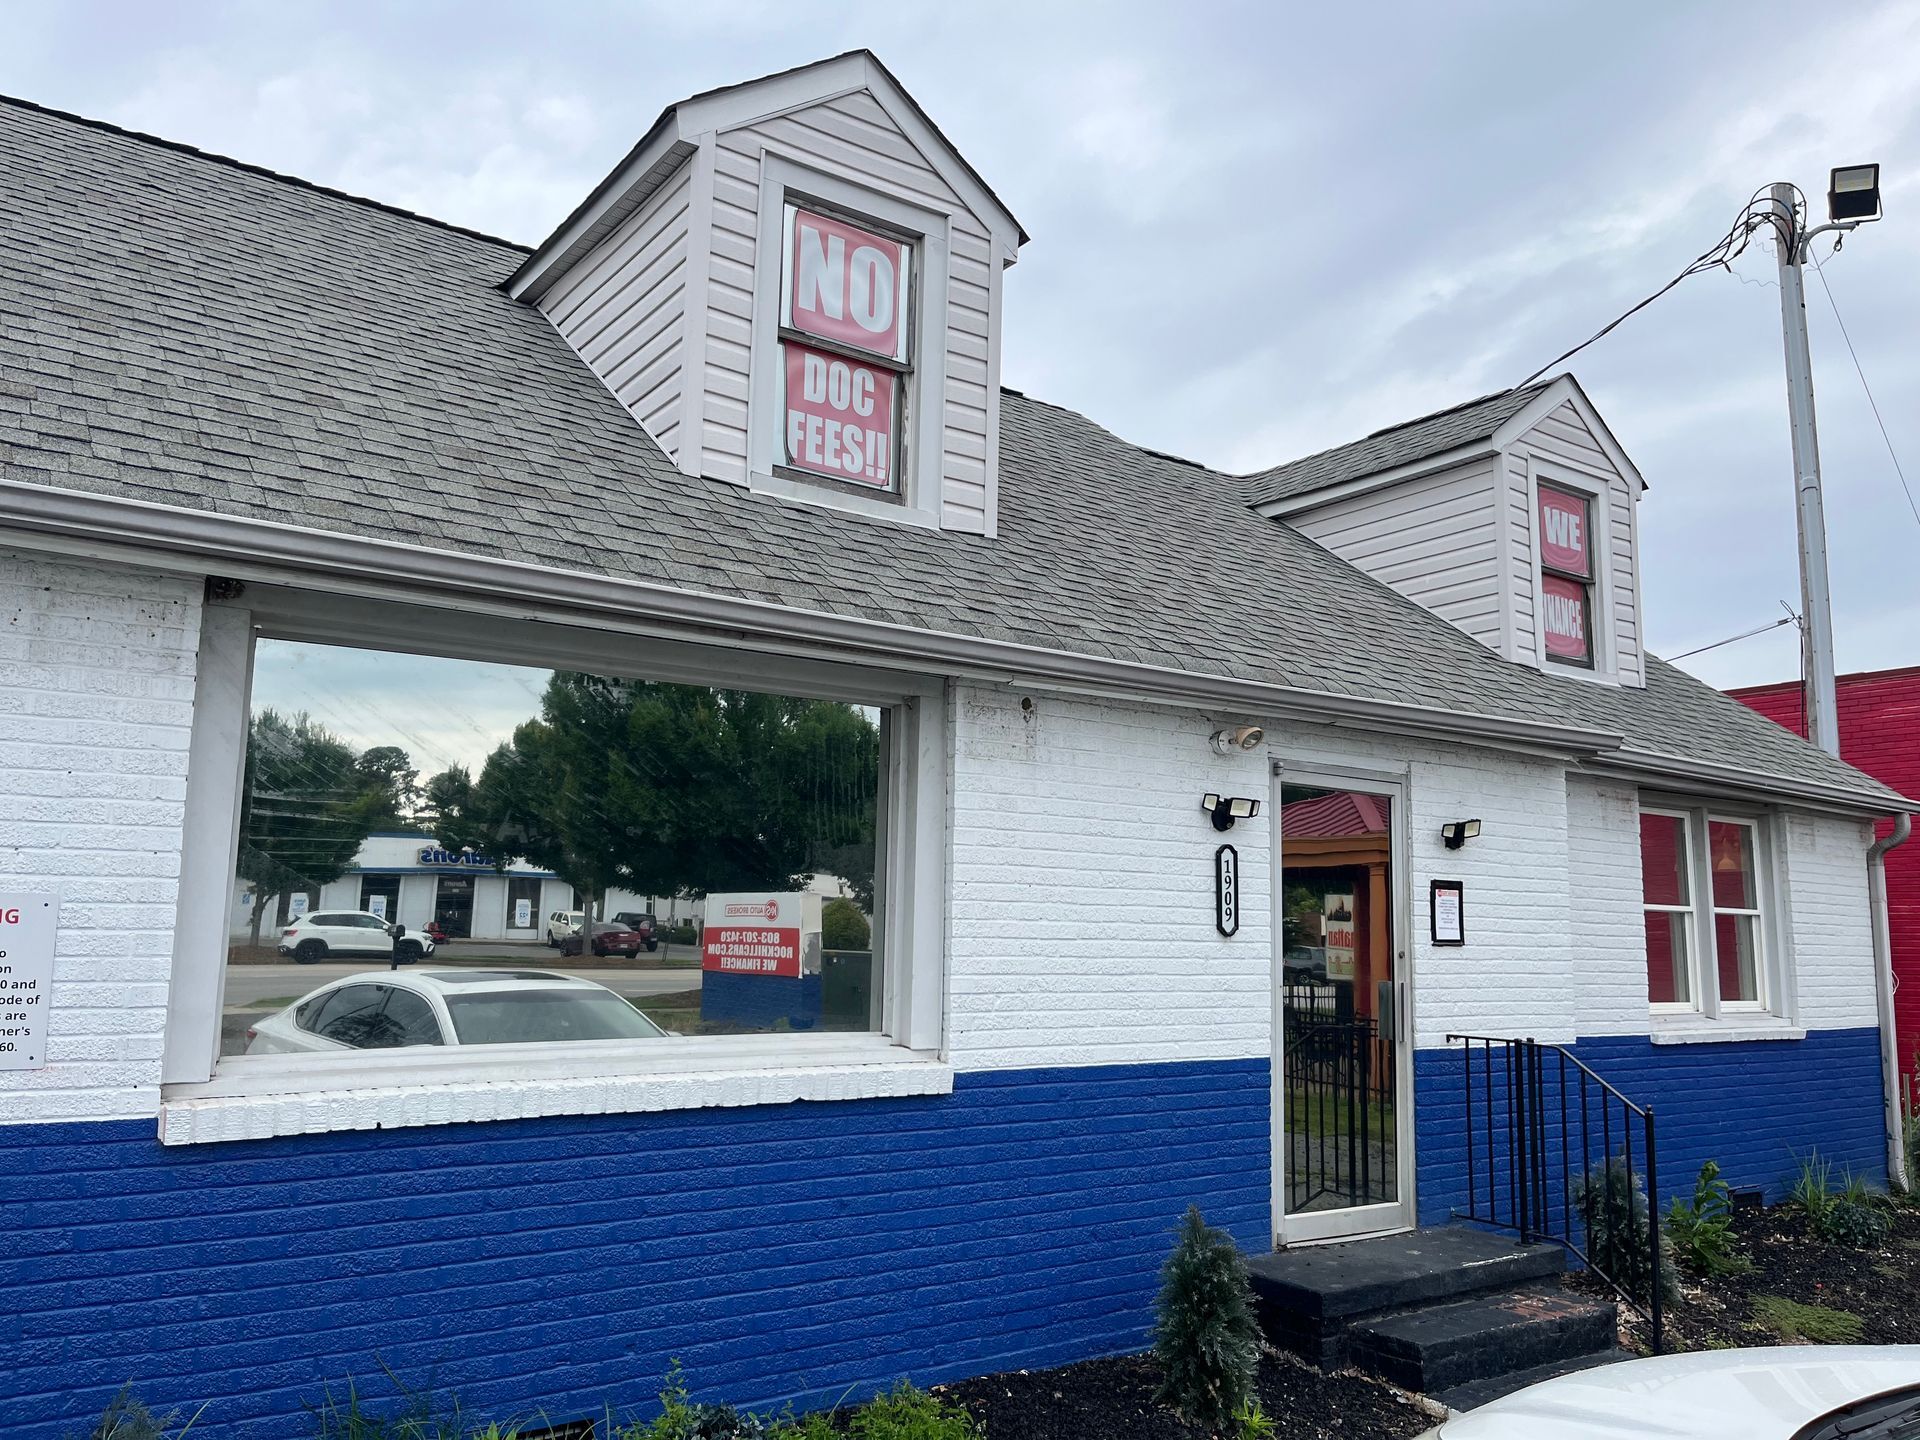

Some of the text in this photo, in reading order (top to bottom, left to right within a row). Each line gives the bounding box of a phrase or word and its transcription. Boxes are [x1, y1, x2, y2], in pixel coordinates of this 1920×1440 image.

[798, 223, 895, 334] NO
[803, 353, 875, 417] DOC
[788, 409, 887, 480] FEES!!
[1543, 505, 1582, 552] WE
[1543, 592, 1584, 640] INANCE
[1223, 858, 1233, 923] 1909
[11, 979, 37, 989] and
[26, 994, 41, 1005] of
[5, 1012, 27, 1021] are
